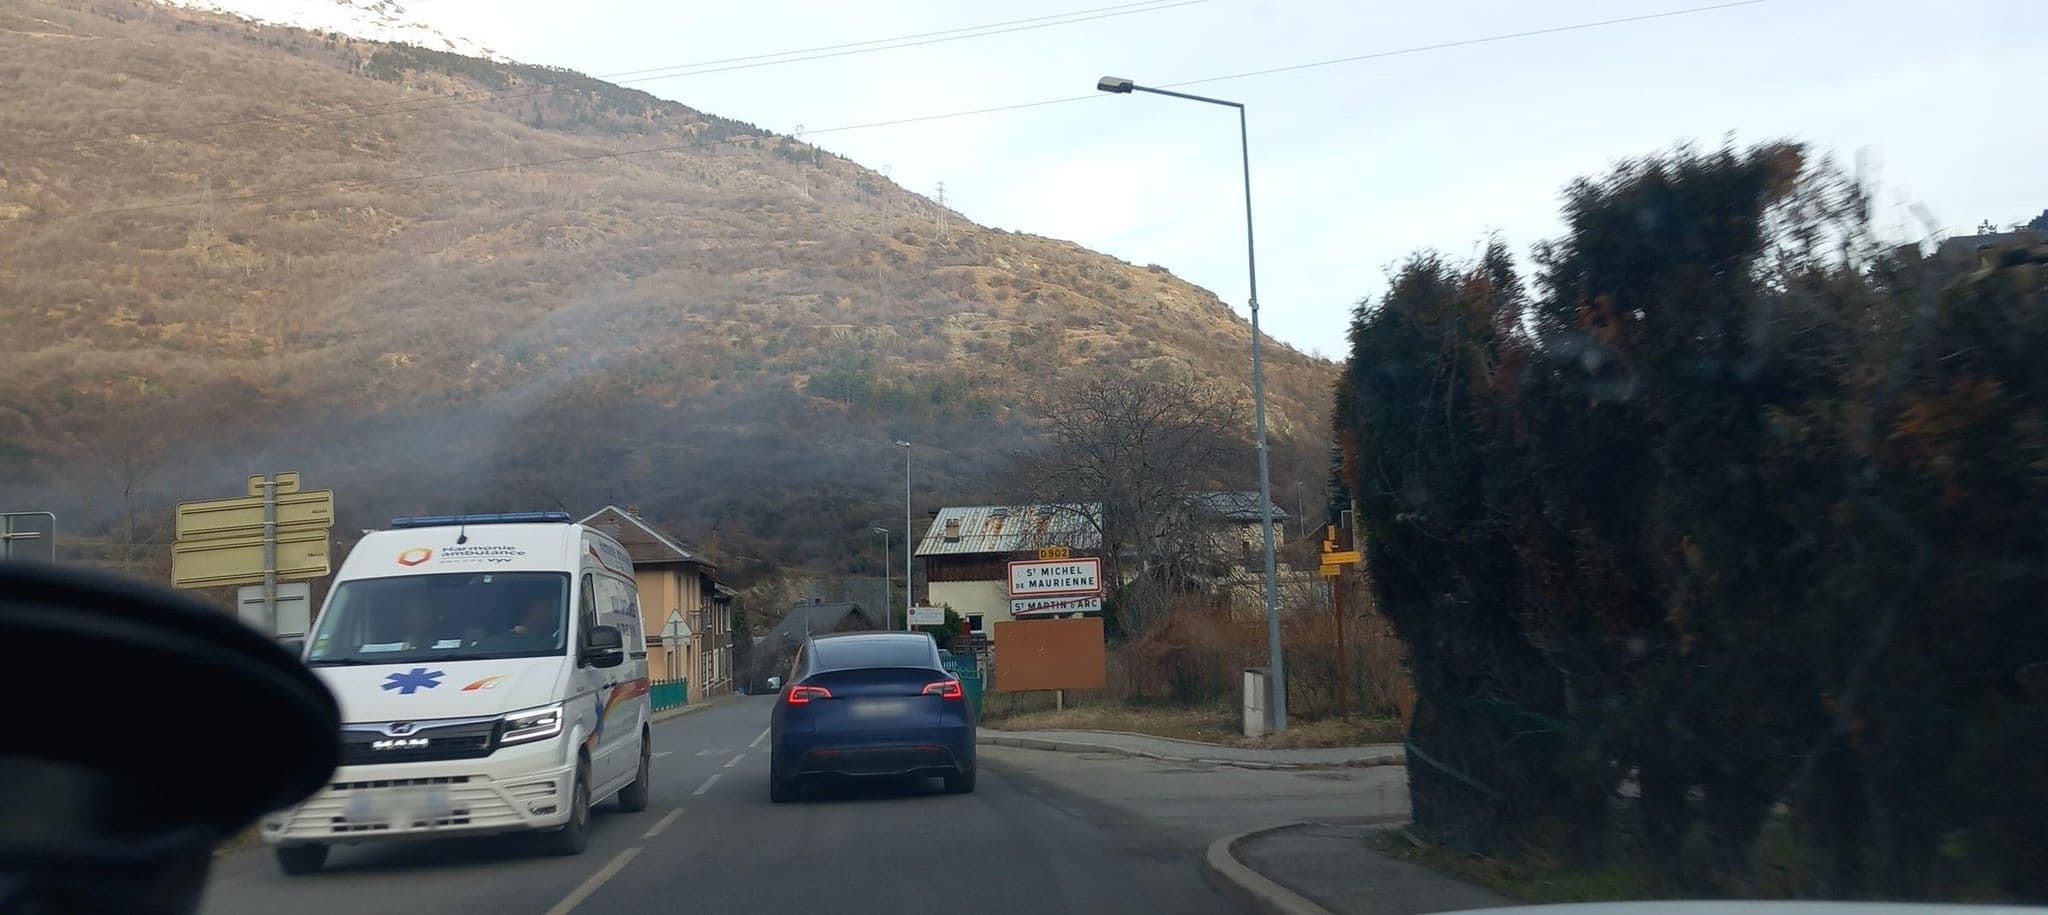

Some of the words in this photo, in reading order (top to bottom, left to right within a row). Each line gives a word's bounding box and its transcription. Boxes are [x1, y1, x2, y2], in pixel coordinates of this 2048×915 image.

[1041, 566, 1083, 576] MICHEL
[1029, 577, 1095, 588] MAURIENNE
[1028, 600, 1067, 611] MARTIN
